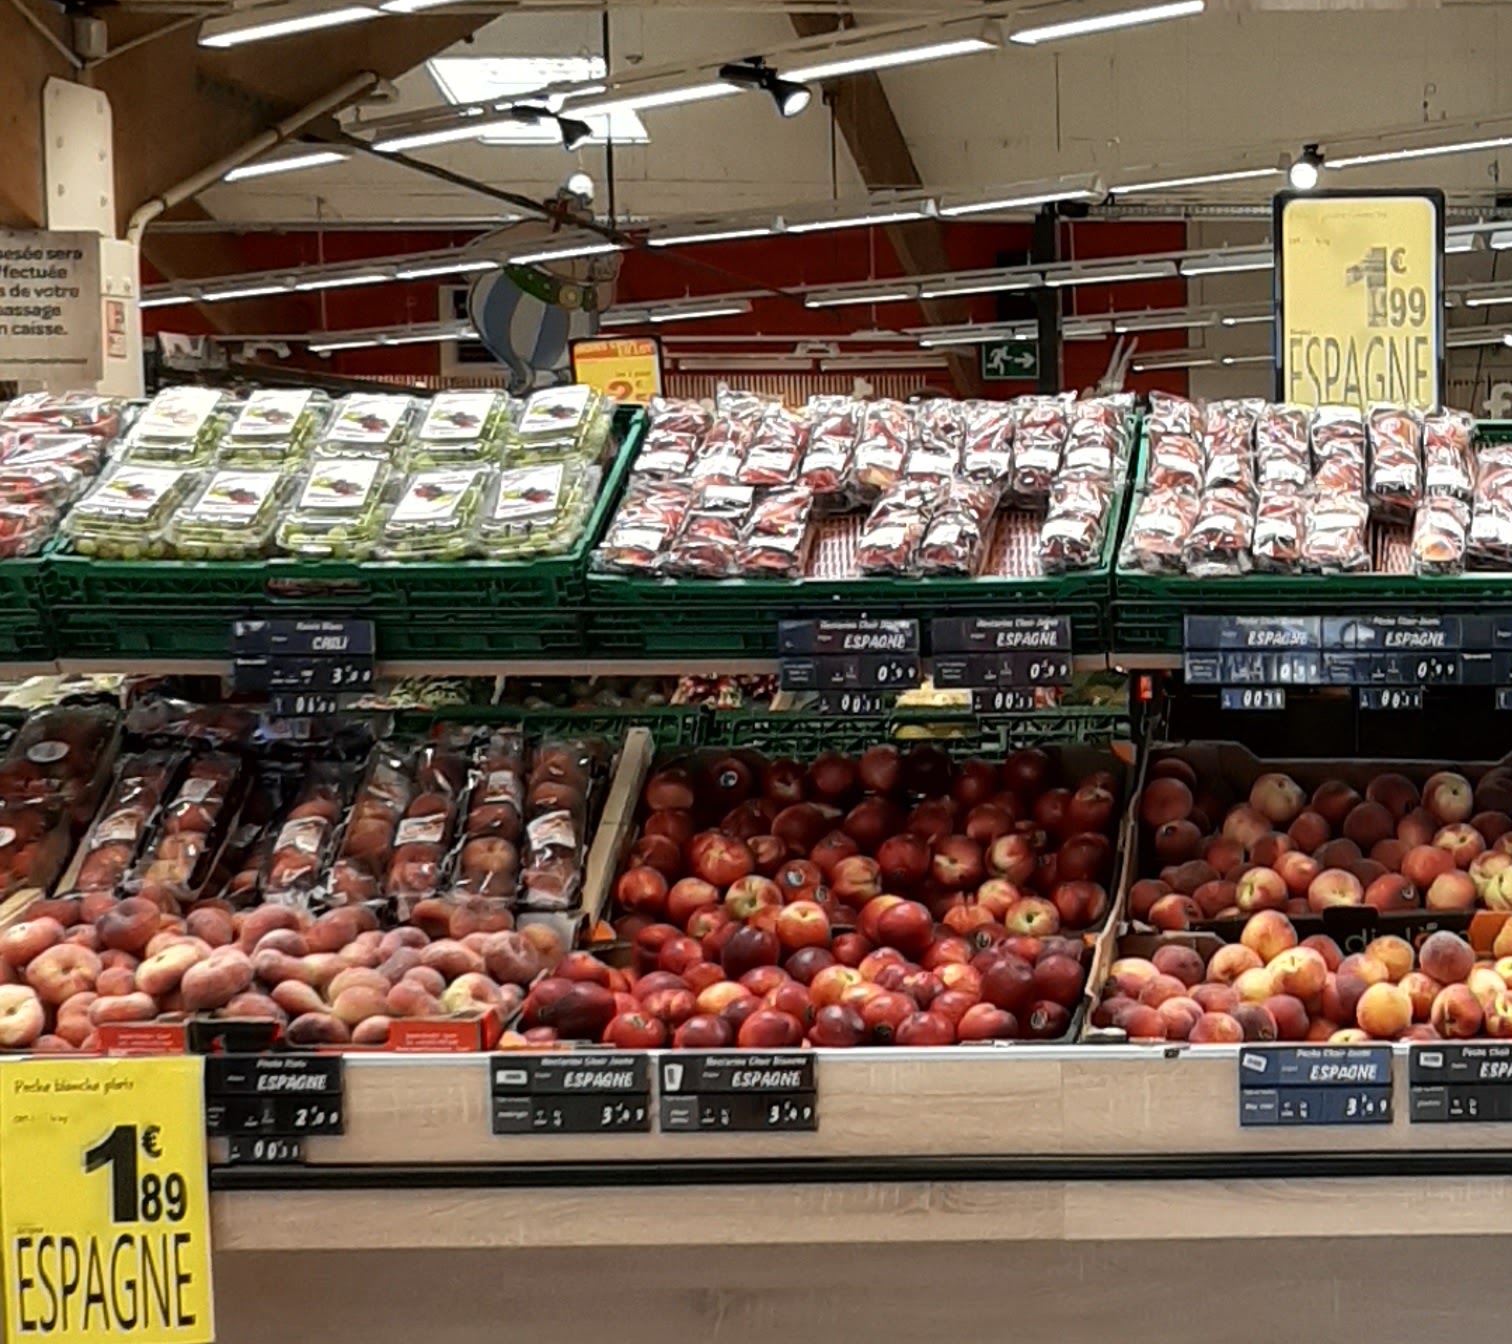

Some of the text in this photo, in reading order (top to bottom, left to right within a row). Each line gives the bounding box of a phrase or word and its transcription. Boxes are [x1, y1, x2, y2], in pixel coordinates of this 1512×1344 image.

[10, 284, 30, 297] de
[34, 285, 80, 297] votre
[1290, 336, 1428, 406] ESPAGNE
[843, 634, 906, 649] ESPAGNE
[996, 631, 1057, 647] ESPAGNE
[1385, 631, 1445, 646] ESPAGNE
[563, 1071, 633, 1088] ESPAGNE
[732, 1071, 801, 1088] ESPAGNE
[1310, 1064, 1378, 1081] ESPAGNE
[257, 1074, 328, 1091] ESPAGNE
[141, 1173, 187, 1222] 89
[17, 1233, 196, 1331] ESPAGNE
